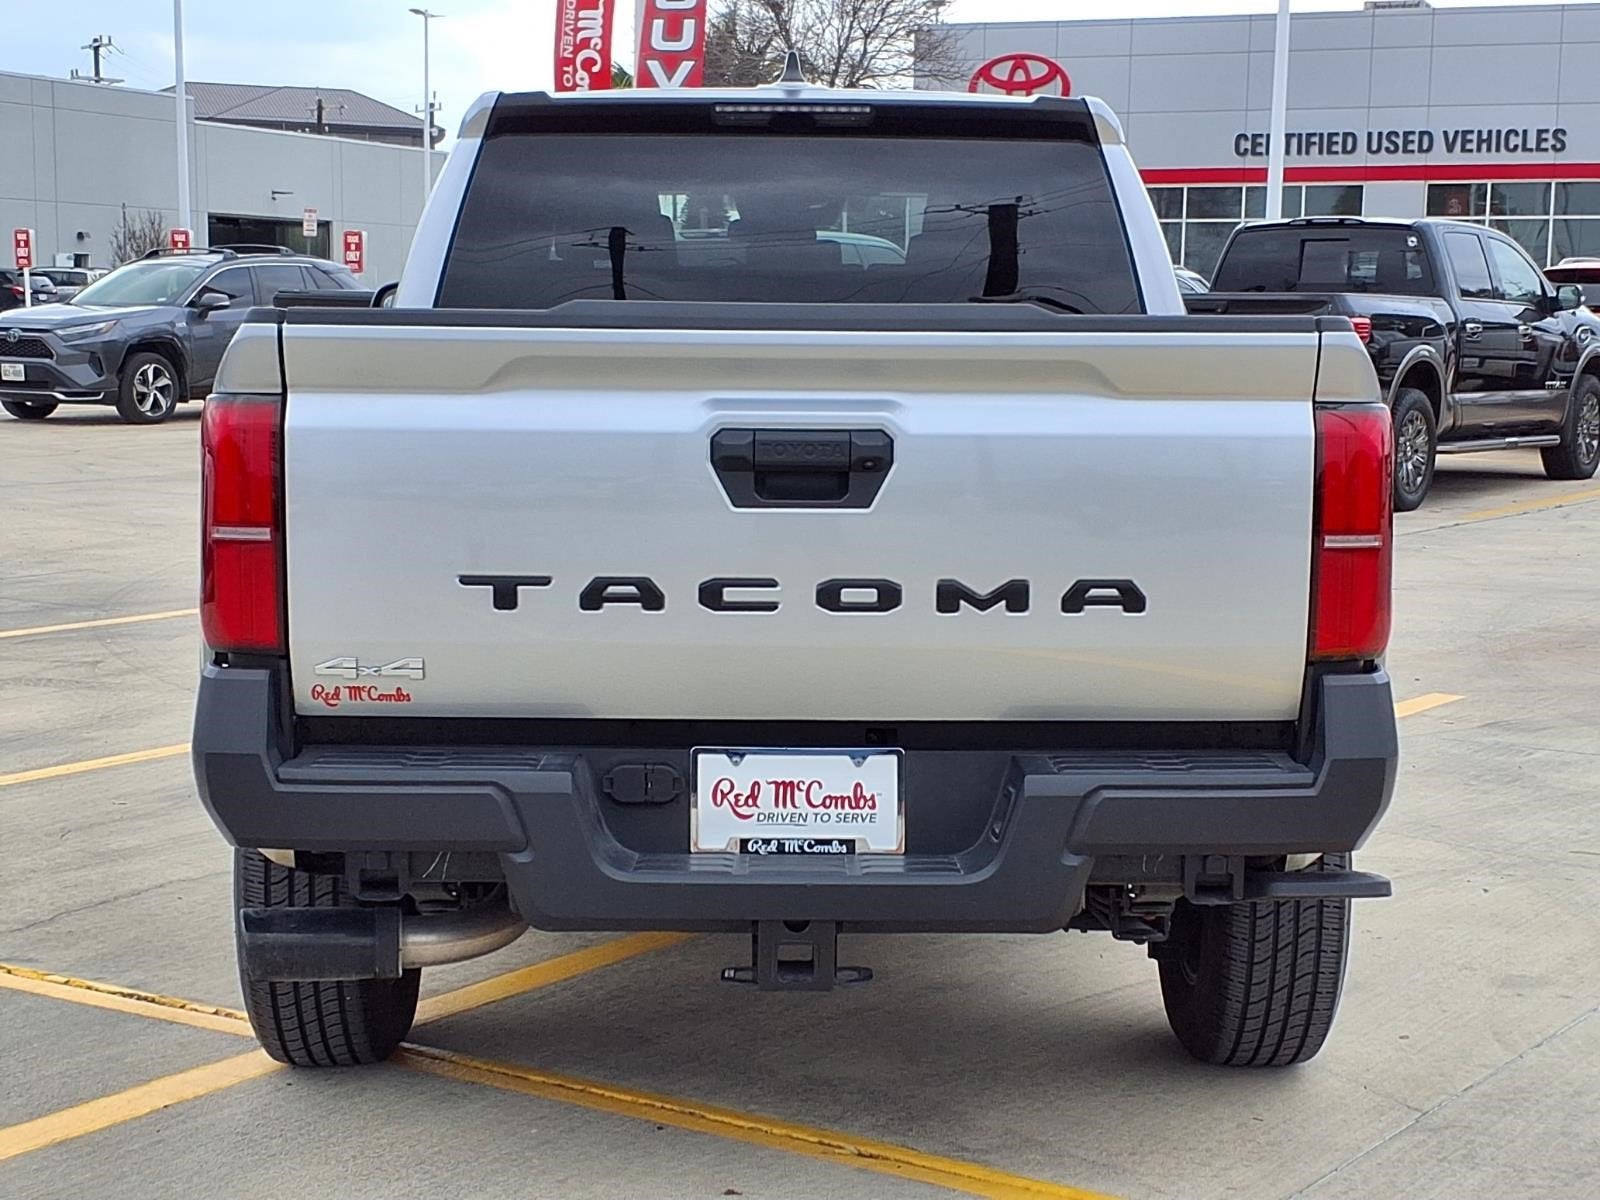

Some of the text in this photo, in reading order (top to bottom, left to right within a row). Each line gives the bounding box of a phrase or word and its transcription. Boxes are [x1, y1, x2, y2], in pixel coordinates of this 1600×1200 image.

[563, 0, 577, 87] DRIVEN TO
[1366, 130, 1434, 155] USED
[1443, 128, 1567, 153] VEHICLES
[759, 442, 845, 458] TOYOTA
[457, 575, 1148, 614] TACOMA
[311, 684, 411, 707] Red McCombs
[711, 778, 877, 820] Red McCombs
[756, 812, 877, 824] DRIVEN TO SERVE
[747, 838, 847, 855] Red McCombs
